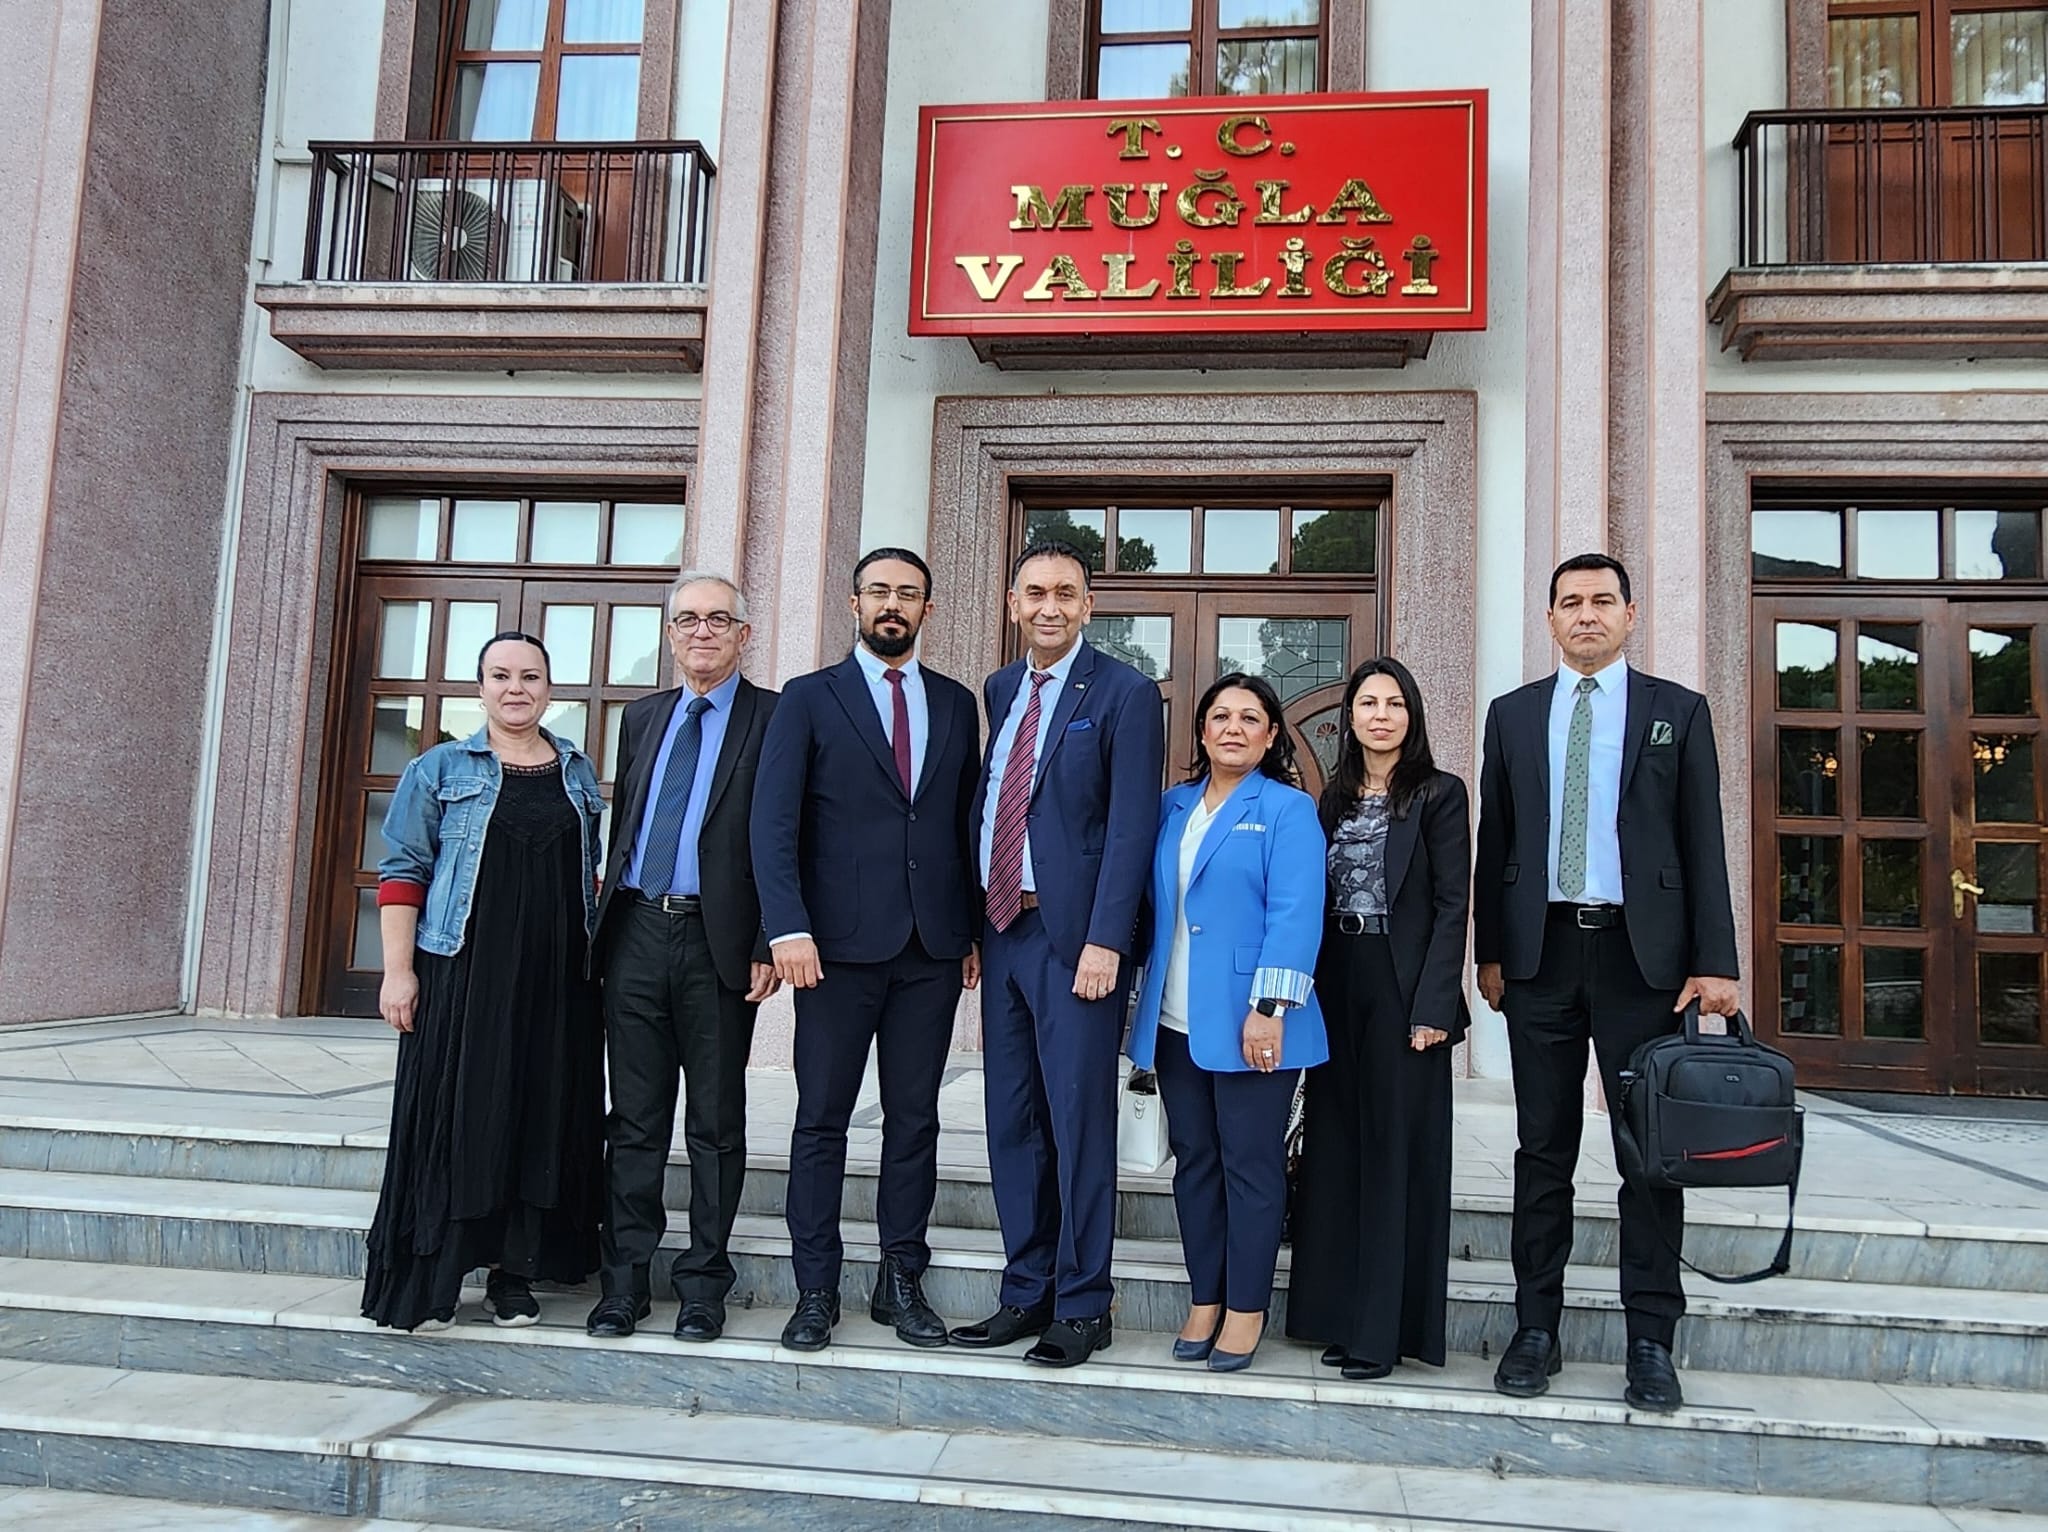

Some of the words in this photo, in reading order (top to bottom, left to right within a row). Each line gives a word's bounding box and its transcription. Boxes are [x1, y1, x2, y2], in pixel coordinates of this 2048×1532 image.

[1106, 119, 1183, 160] T.
[1216, 116, 1296, 156] C.
[1009, 168, 1394, 231] MUĞLA
[954, 235, 1440, 300] VALİLİĞİ
